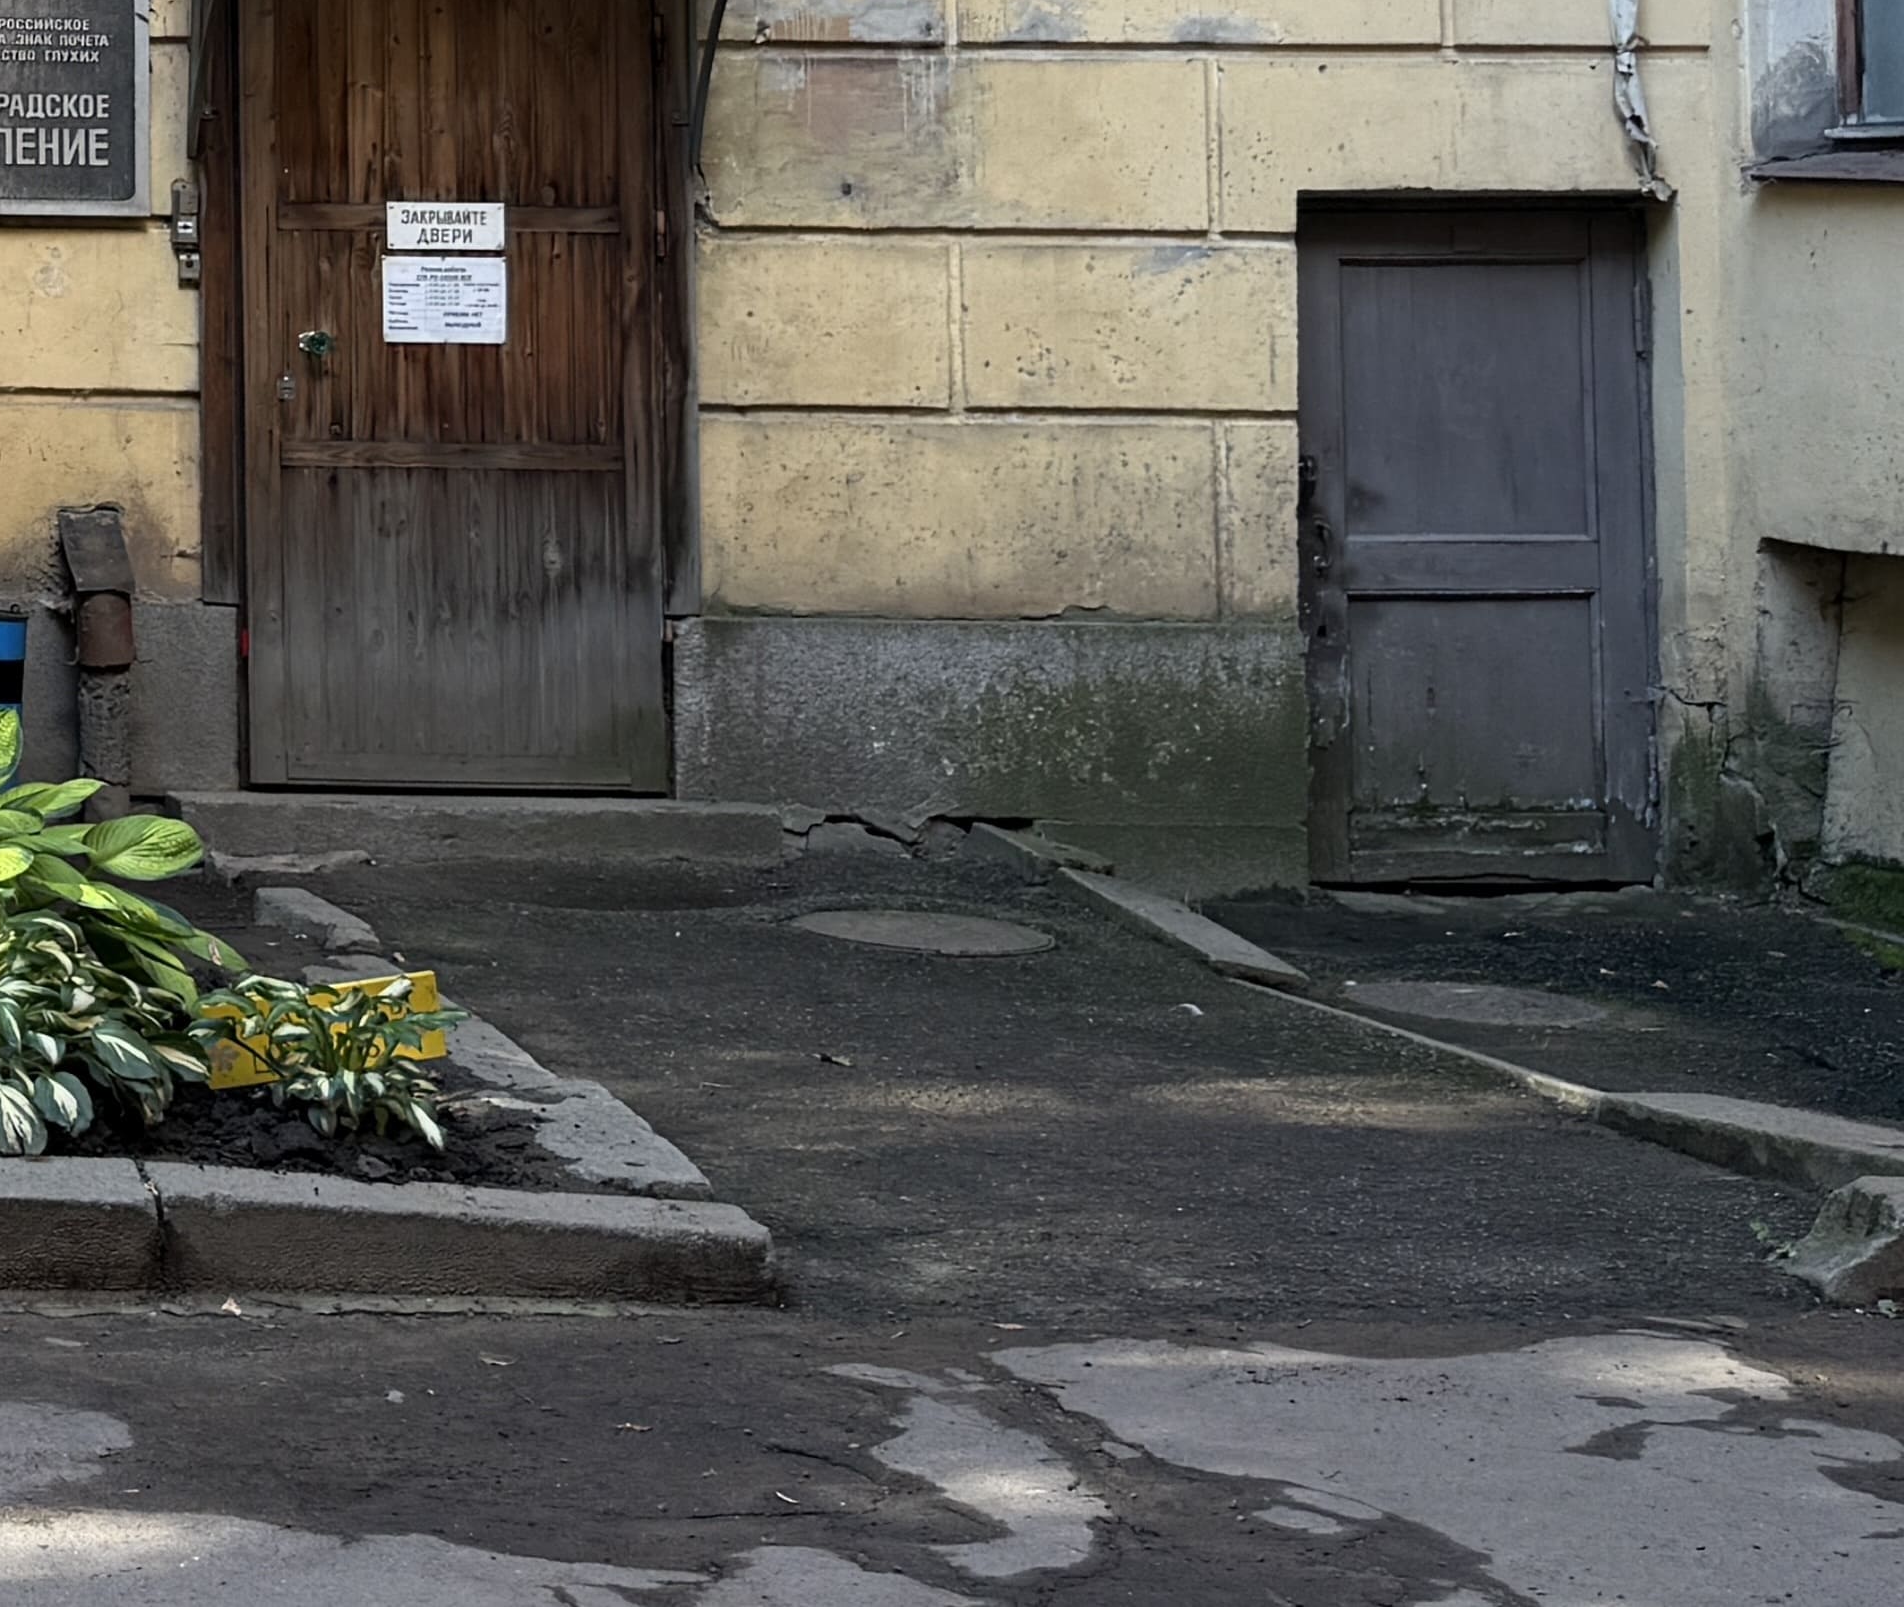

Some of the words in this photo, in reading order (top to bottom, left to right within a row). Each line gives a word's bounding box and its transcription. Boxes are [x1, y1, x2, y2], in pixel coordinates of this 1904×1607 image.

[44, 50, 100, 62] ГЛУХИХ
[401, 209, 487, 225] ЗАКРЫВАЙТЕ
[417, 228, 473, 244] ДВЕРИ
